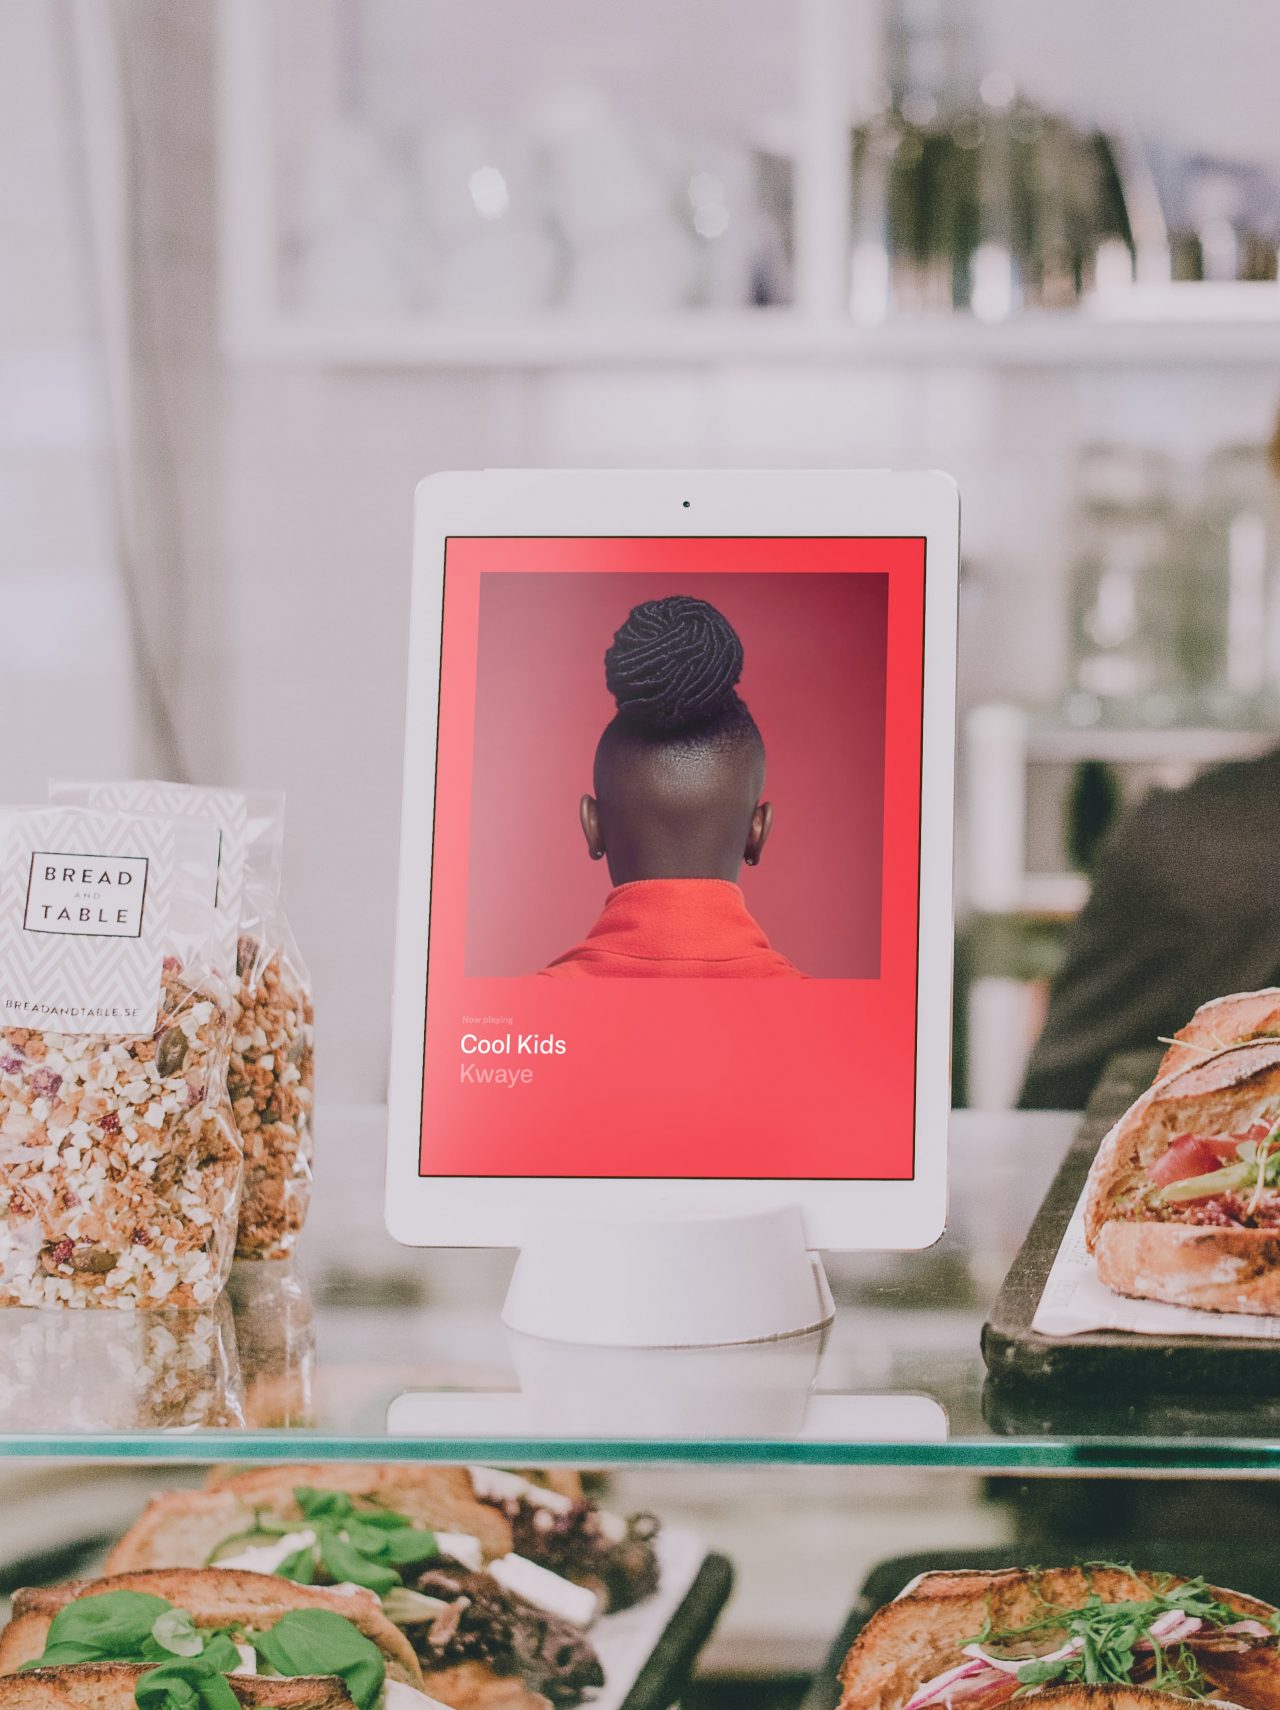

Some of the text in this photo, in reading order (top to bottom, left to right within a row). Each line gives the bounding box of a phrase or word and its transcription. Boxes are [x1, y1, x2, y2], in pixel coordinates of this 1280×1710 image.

[44, 866, 133, 886] BREAD
[74, 891, 102, 900] AND
[41, 905, 129, 924] TABLE
[5, 998, 140, 1017] BREADANDTABLE.SE
[462, 1015, 514, 1026] Now playing
[460, 1033, 567, 1055] Cool Kids
[460, 1063, 534, 1088] Kwaye
